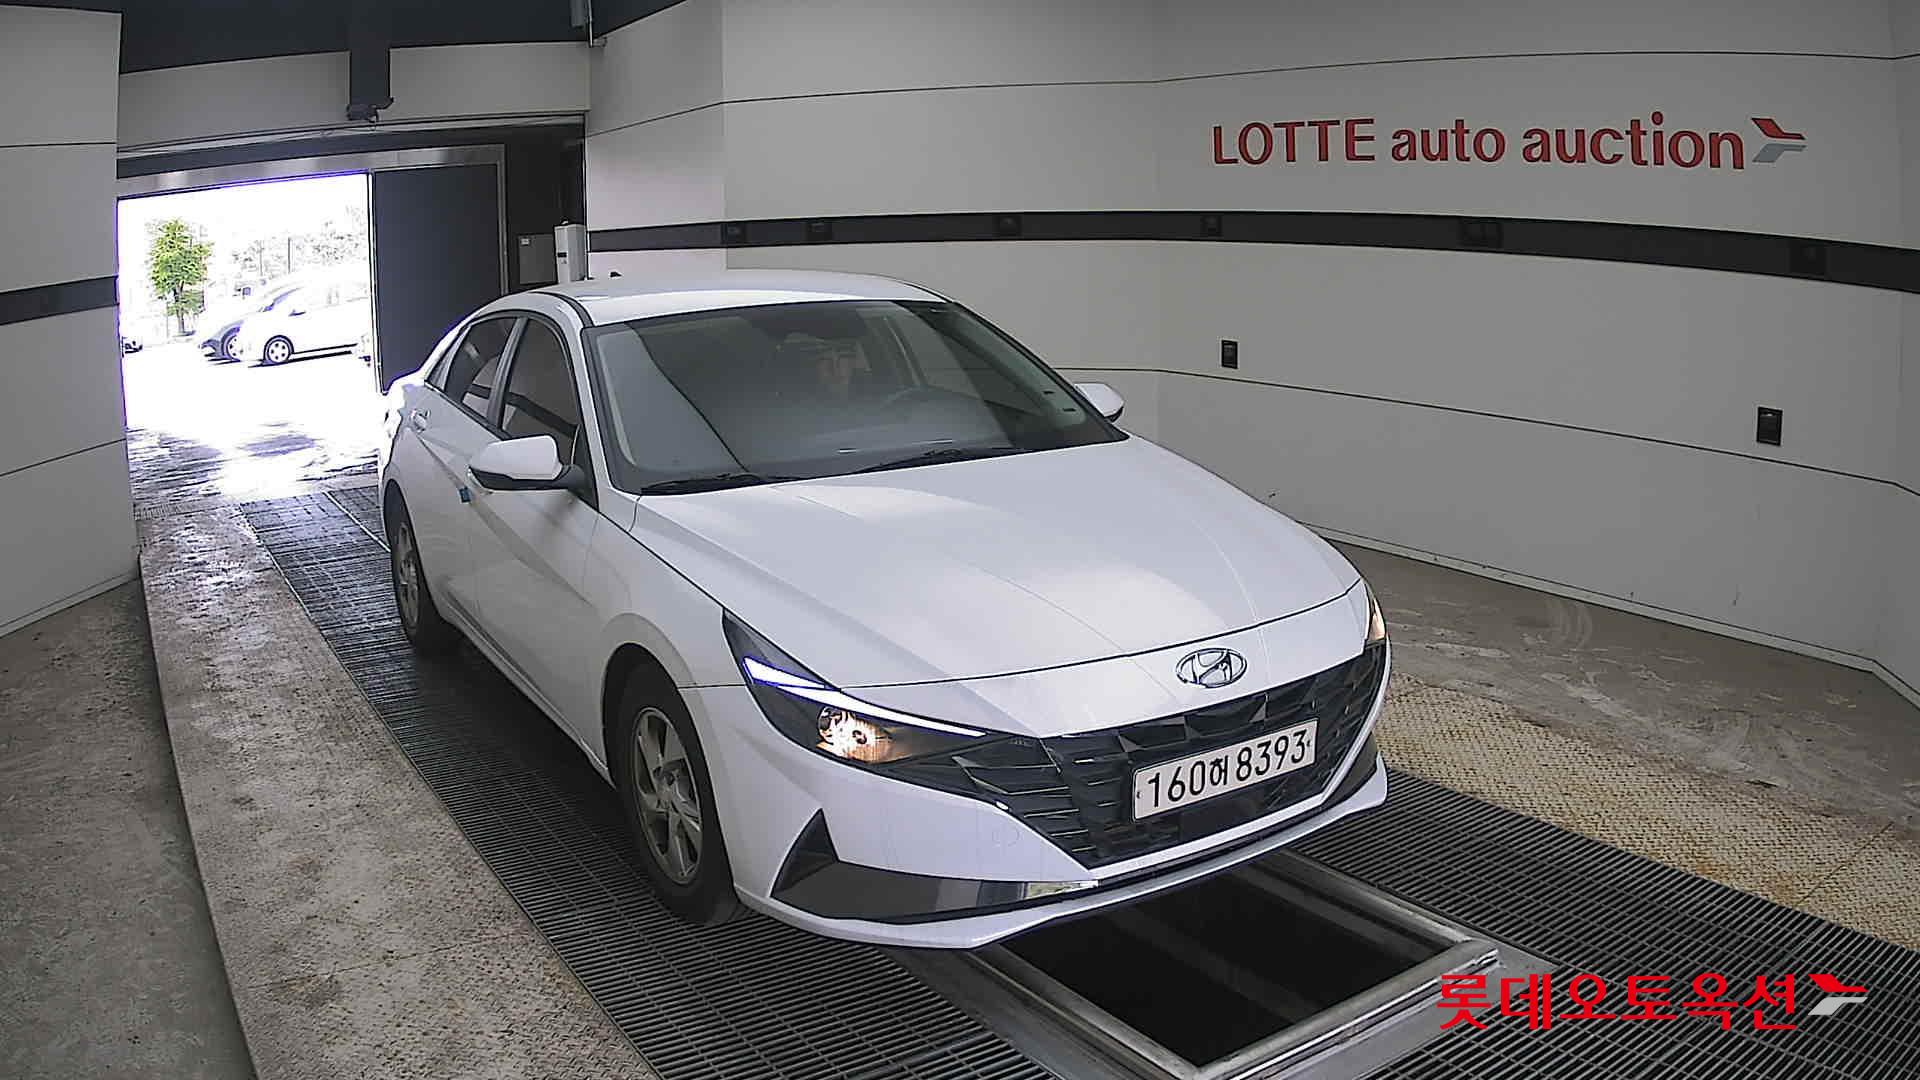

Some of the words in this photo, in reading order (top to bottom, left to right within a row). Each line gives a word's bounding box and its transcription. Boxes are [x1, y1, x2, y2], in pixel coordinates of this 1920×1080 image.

[1213, 118, 1376, 164] LOTTE
[1391, 118, 1506, 162] auto
[1522, 111, 1745, 170] auction
[1236, 729, 1307, 782] 8393
